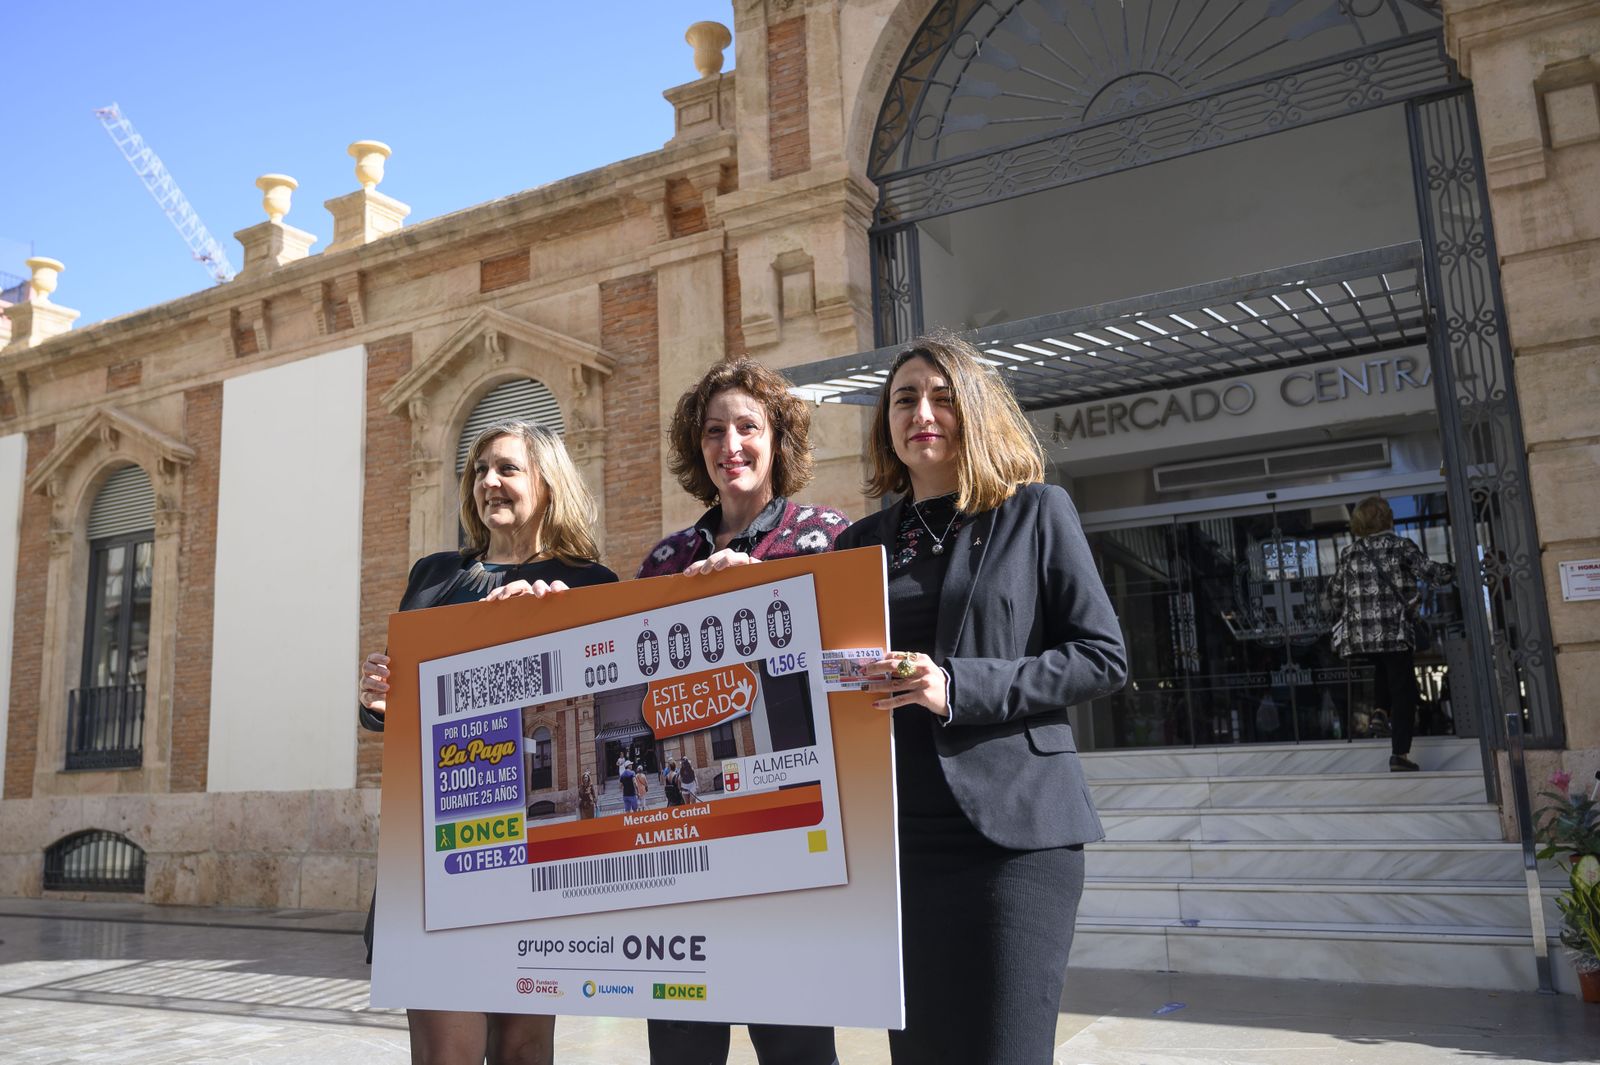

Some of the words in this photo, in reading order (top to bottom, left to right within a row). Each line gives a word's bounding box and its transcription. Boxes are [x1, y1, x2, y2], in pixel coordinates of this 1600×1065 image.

[1054, 381, 1256, 443] MERCADO
[1280, 347, 1474, 408] CENTRL
[774, 589, 779, 598] R
[768, 613, 776, 638] ONCE
[783, 610, 791, 634] ONCE
[584, 640, 615, 658] SERIE
[584, 662, 618, 688] 000
[652, 683, 688, 706] ESTE
[692, 681, 709, 695] es
[712, 670, 735, 691] TU
[444, 727, 458, 740] POR
[492, 716, 508, 730] MÁS
[438, 744, 467, 767] La
[467, 739, 515, 764] Paga
[753, 749, 819, 774] ALMERÍA
[486, 770, 496, 784] AL
[499, 766, 517, 782] MES
[753, 772, 787, 785] CIUDAD
[441, 792, 479, 811] DURANTE
[481, 790, 492, 804] 25
[494, 785, 518, 802] AÑOS
[624, 812, 668, 826] Mercado
[672, 804, 710, 819] Central
[460, 818, 519, 843] ONCE
[635, 824, 699, 845] ALMERÍA
[456, 854, 472, 871] 10
[476, 849, 506, 869] FEB.
[510, 846, 526, 865] 20
[518, 937, 565, 957] grupo
[568, 936, 614, 954] social
[623, 935, 706, 961] ONCE
[598, 985, 634, 994] ILUNION
[668, 986, 704, 998] ONCE
